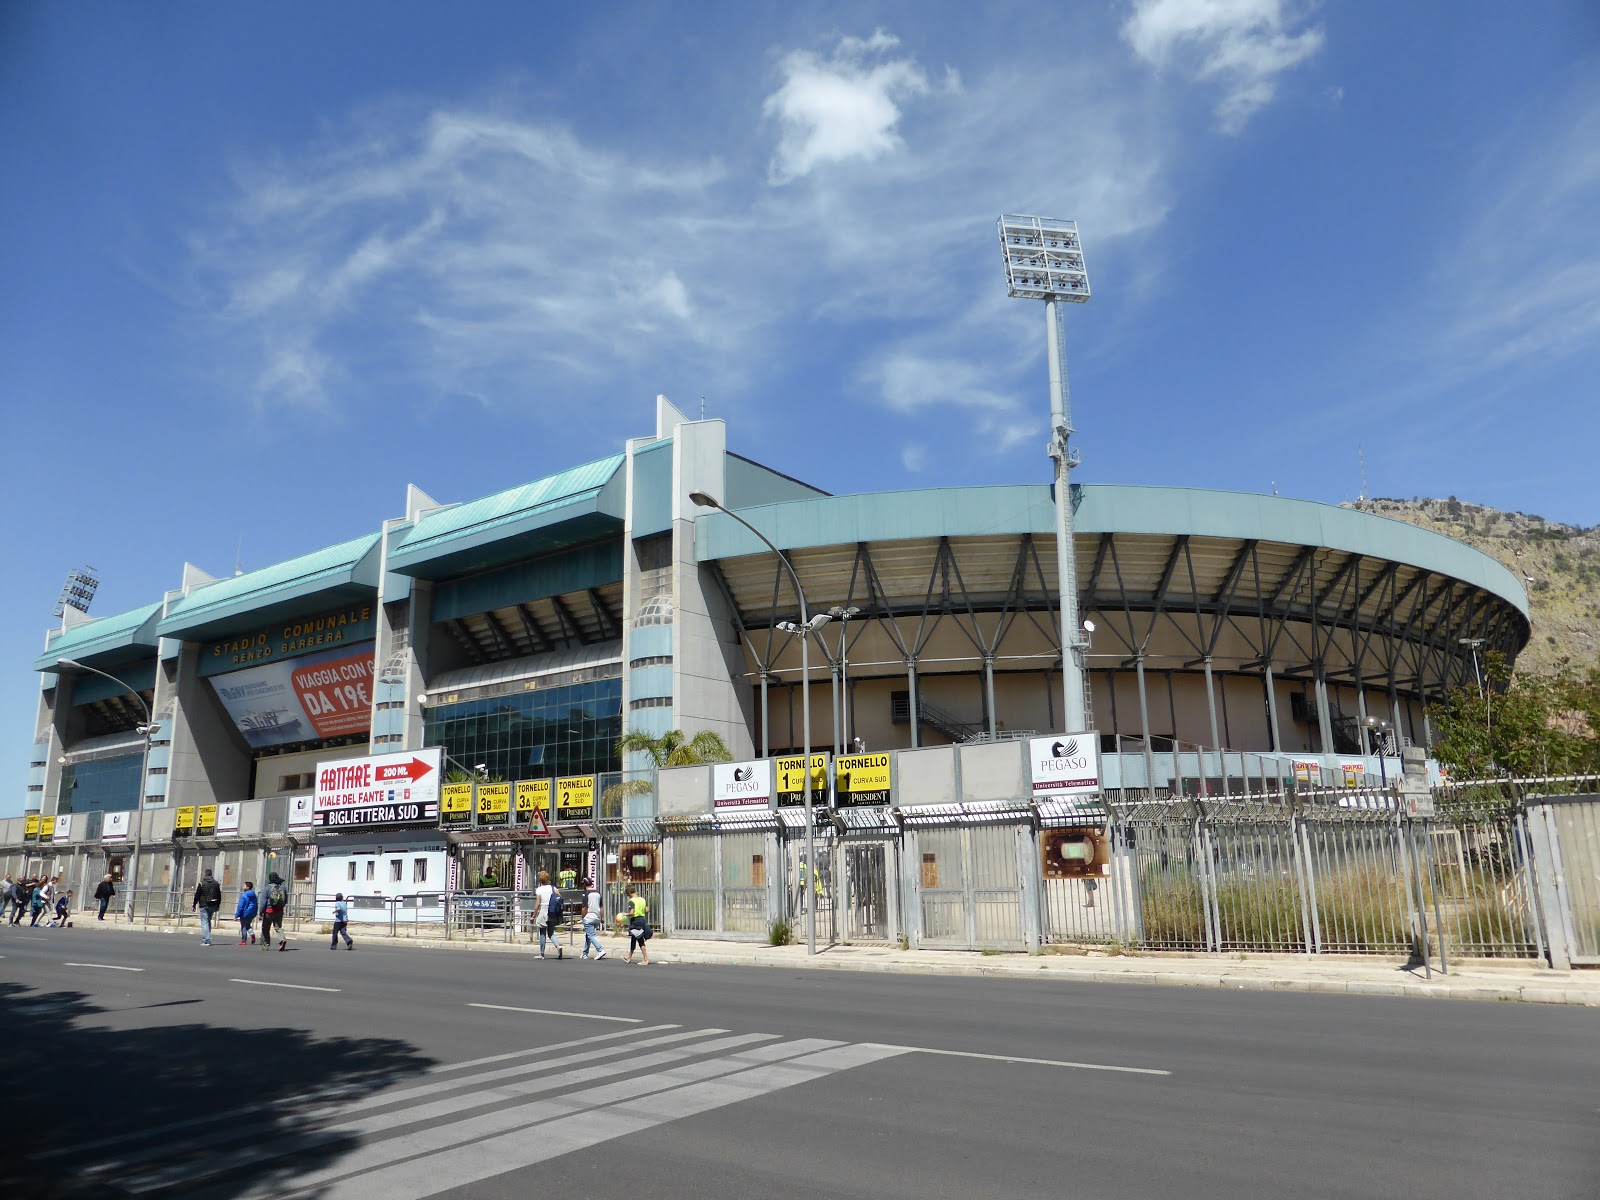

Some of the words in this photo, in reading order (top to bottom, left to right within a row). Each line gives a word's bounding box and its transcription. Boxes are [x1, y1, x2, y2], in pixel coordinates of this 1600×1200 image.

[214, 633, 267, 656] STADIO
[283, 608, 370, 639] COMUNALE
[232, 647, 272, 664] RENZO
[281, 631, 343, 652] BARBERA
[296, 668, 341, 690] VIAGGIA
[340, 663, 367, 681] CON
[303, 690, 336, 716] DA
[333, 682, 373, 710] 19€
[839, 757, 887, 770] TORNELLO
[1040, 757, 1087, 772] PEGASO
[320, 763, 371, 792] ABITARE
[383, 767, 397, 777] 200
[559, 779, 592, 789] TORNELLO
[725, 781, 759, 793] PEGASO
[782, 773, 789, 789] 1
[844, 772, 851, 789] 1
[1035, 781, 1063, 789] Università
[444, 786, 471, 795] TORNELLO
[480, 786, 509, 796] TORNELLO
[518, 783, 549, 792] TORNELLO
[319, 794, 341, 807] VIALE
[342, 793, 357, 805] DEL
[358, 790, 385, 804] FANTE
[447, 797, 453, 810] 4
[519, 795, 531, 808] 3A
[563, 792, 570, 806] 2
[852, 791, 888, 803] PRESIDENT
[480, 797, 492, 811] 3B
[177, 815, 182, 826] 5
[198, 815, 203, 826] 5
[328, 807, 396, 825] BIGLIETTERIA
[397, 805, 419, 819] SUD
[469, 831, 507, 841] TESSERA
